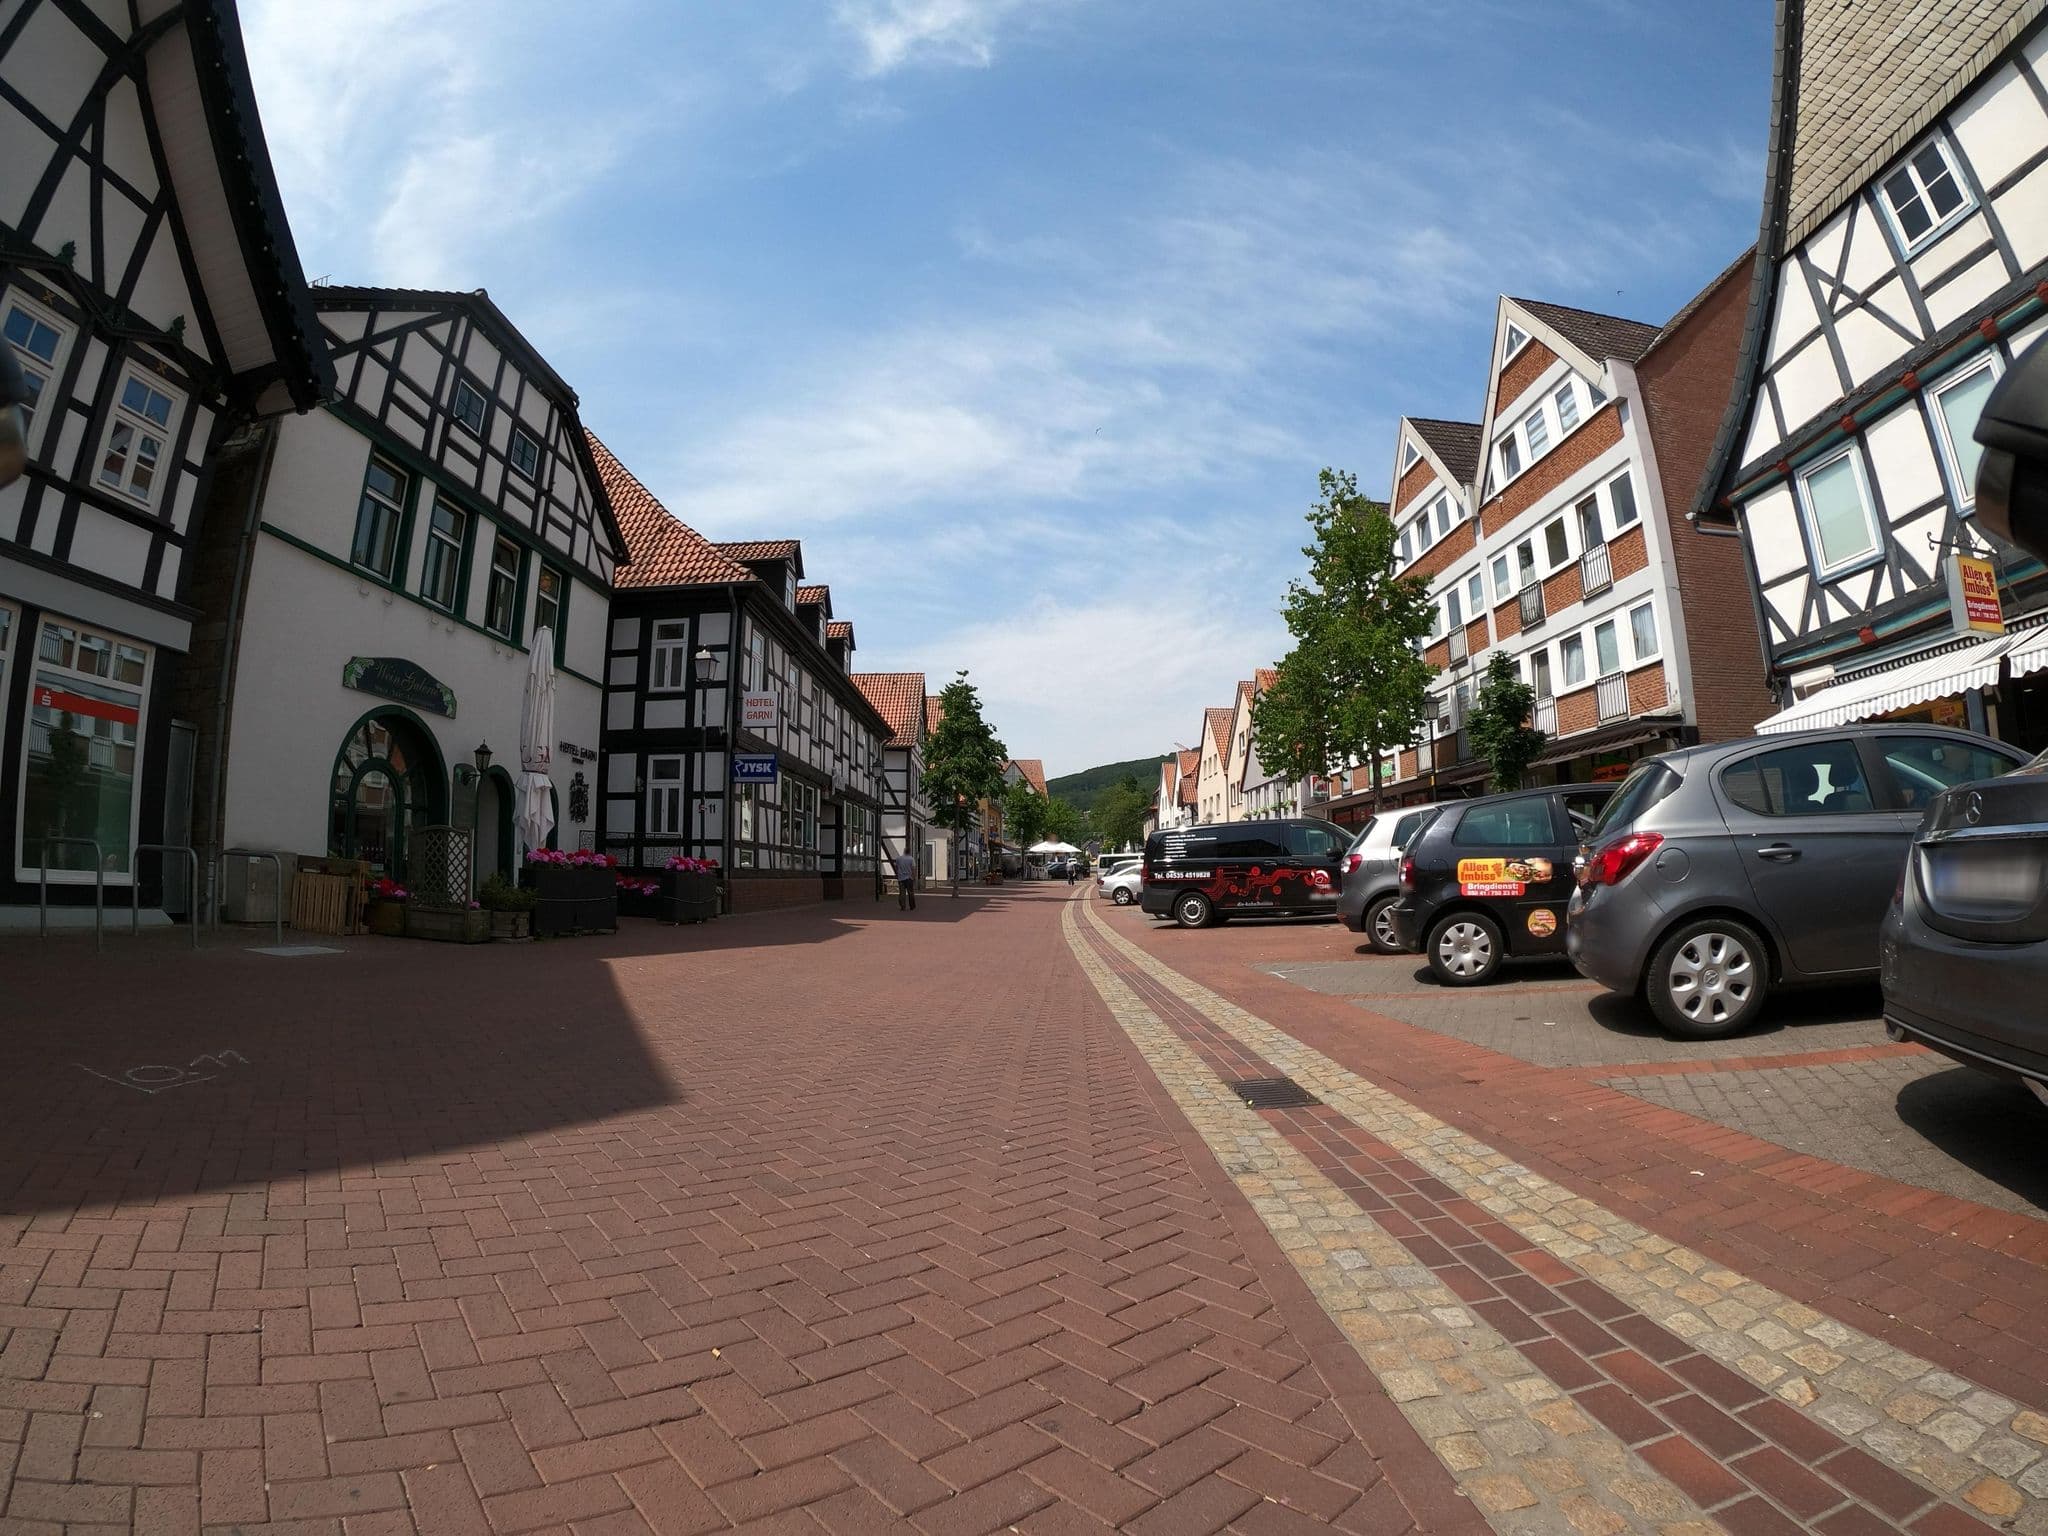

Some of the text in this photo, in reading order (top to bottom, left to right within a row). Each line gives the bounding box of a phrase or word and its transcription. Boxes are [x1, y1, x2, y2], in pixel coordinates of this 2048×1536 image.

[1963, 565, 1984, 582] Allen
[1964, 579, 1992, 596] Imbiss
[745, 698, 774, 708] HOTEL
[746, 711, 773, 720] GARNI
[742, 762, 772, 773] JYSK
[1460, 872, 1496, 881] Imbiss
[1467, 883, 1519, 892] Bringdienst:
